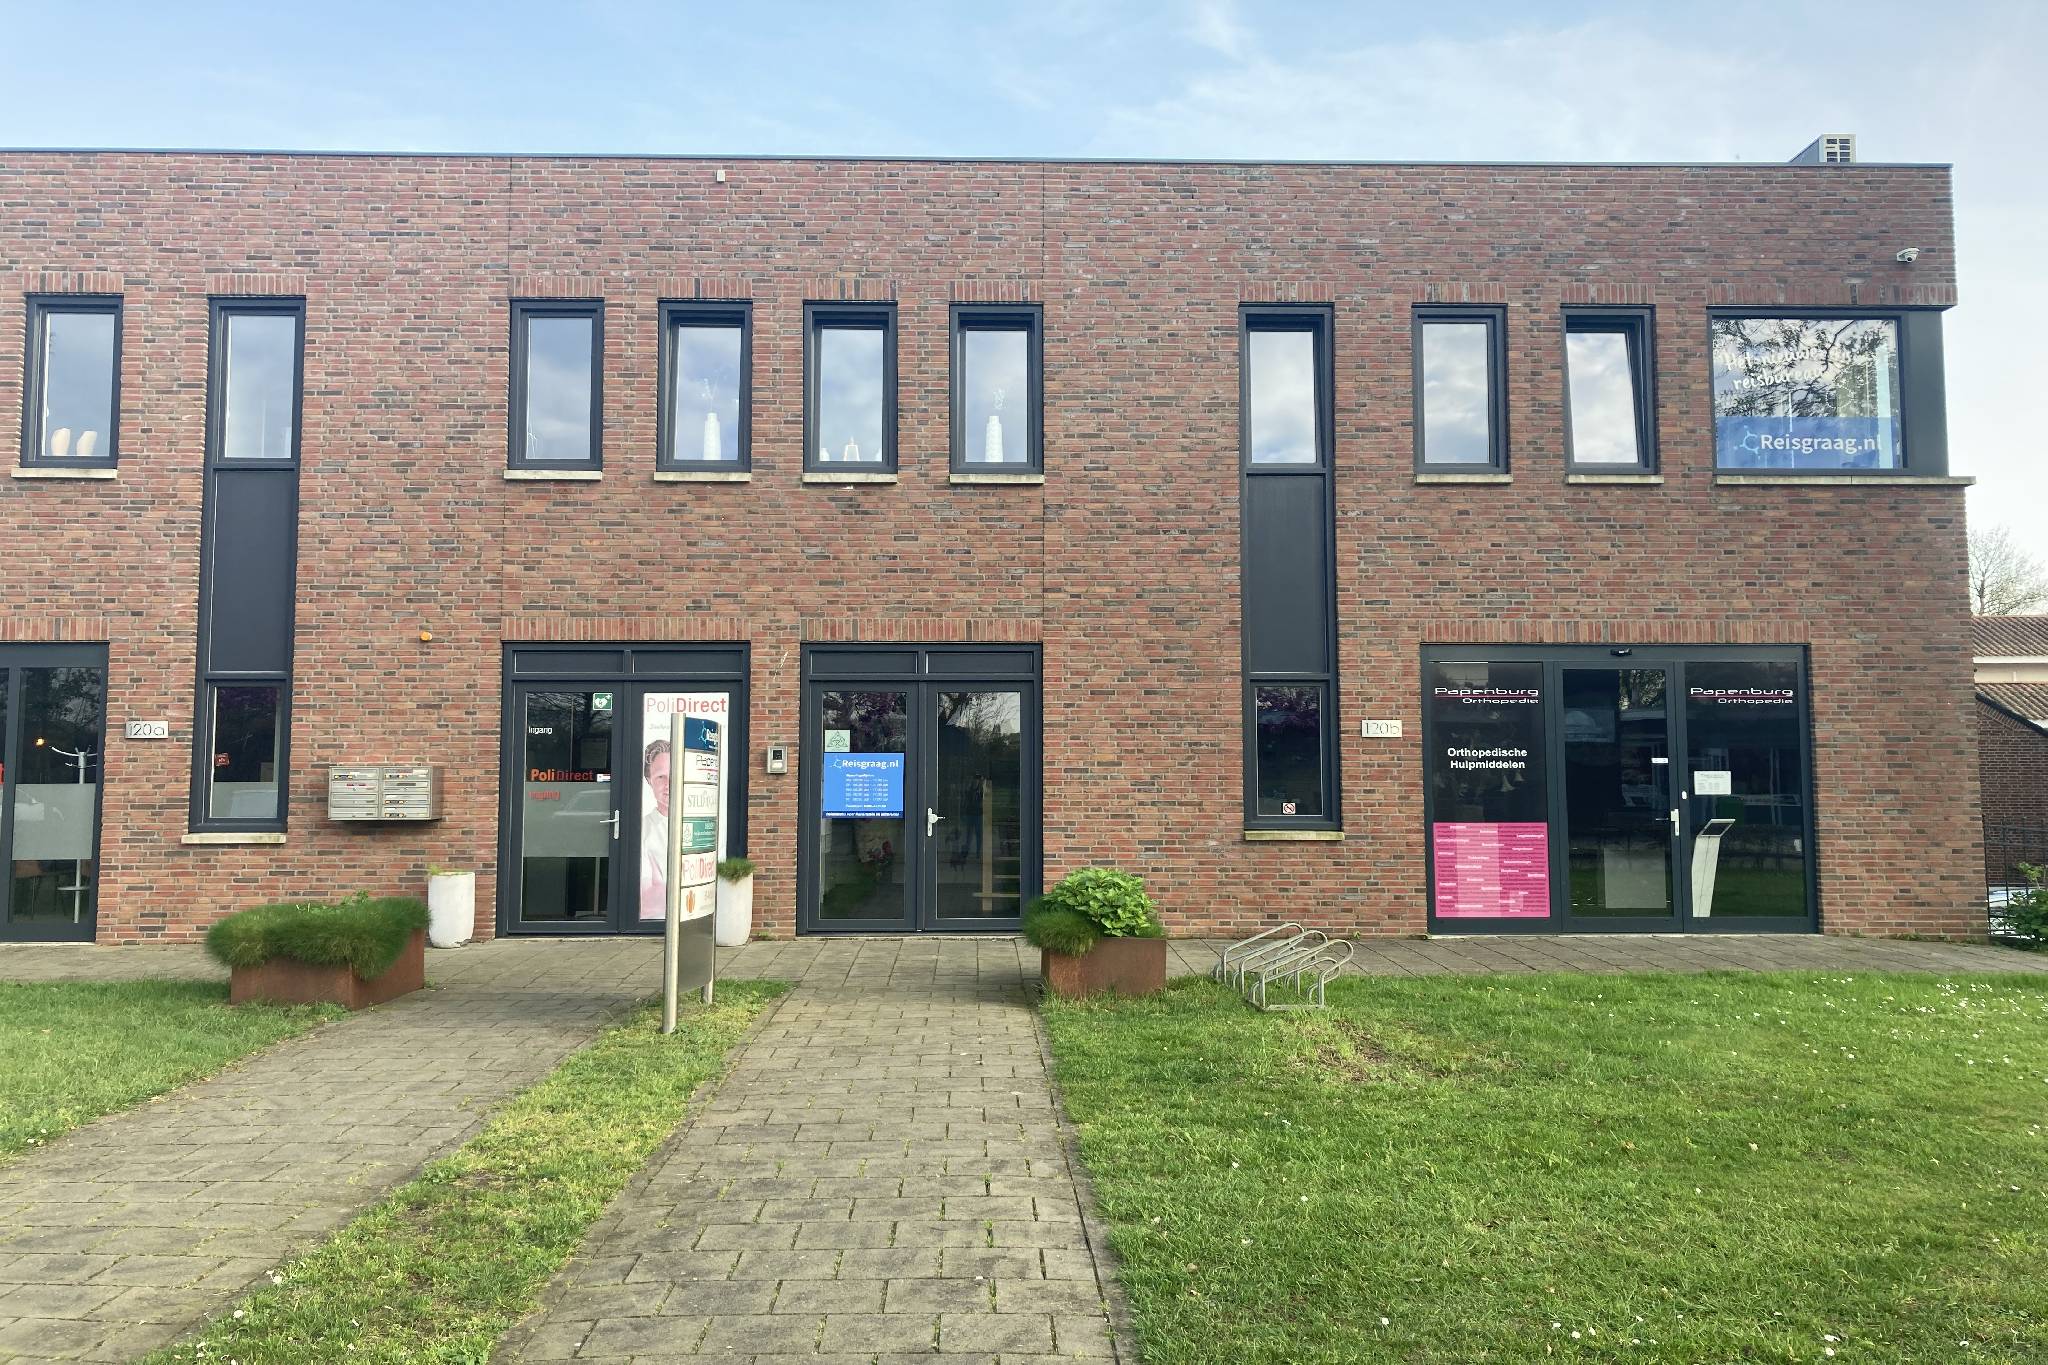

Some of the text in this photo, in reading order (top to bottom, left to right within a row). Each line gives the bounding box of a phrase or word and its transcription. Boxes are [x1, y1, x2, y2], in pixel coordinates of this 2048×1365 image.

[1724, 350, 1752, 371] Het
[1733, 367, 1824, 391] reisbureau
[1761, 434, 1881, 454] Reisgraag.nl
[1434, 687, 1539, 697] Papenburg
[1690, 687, 1794, 697] Papenburg
[646, 698, 727, 713] PoliDirect
[1447, 748, 1528, 759] Orthopedische
[842, 760, 899, 770] Reisgraag.nl
[1450, 760, 1526, 771] Hulpmiddelen
